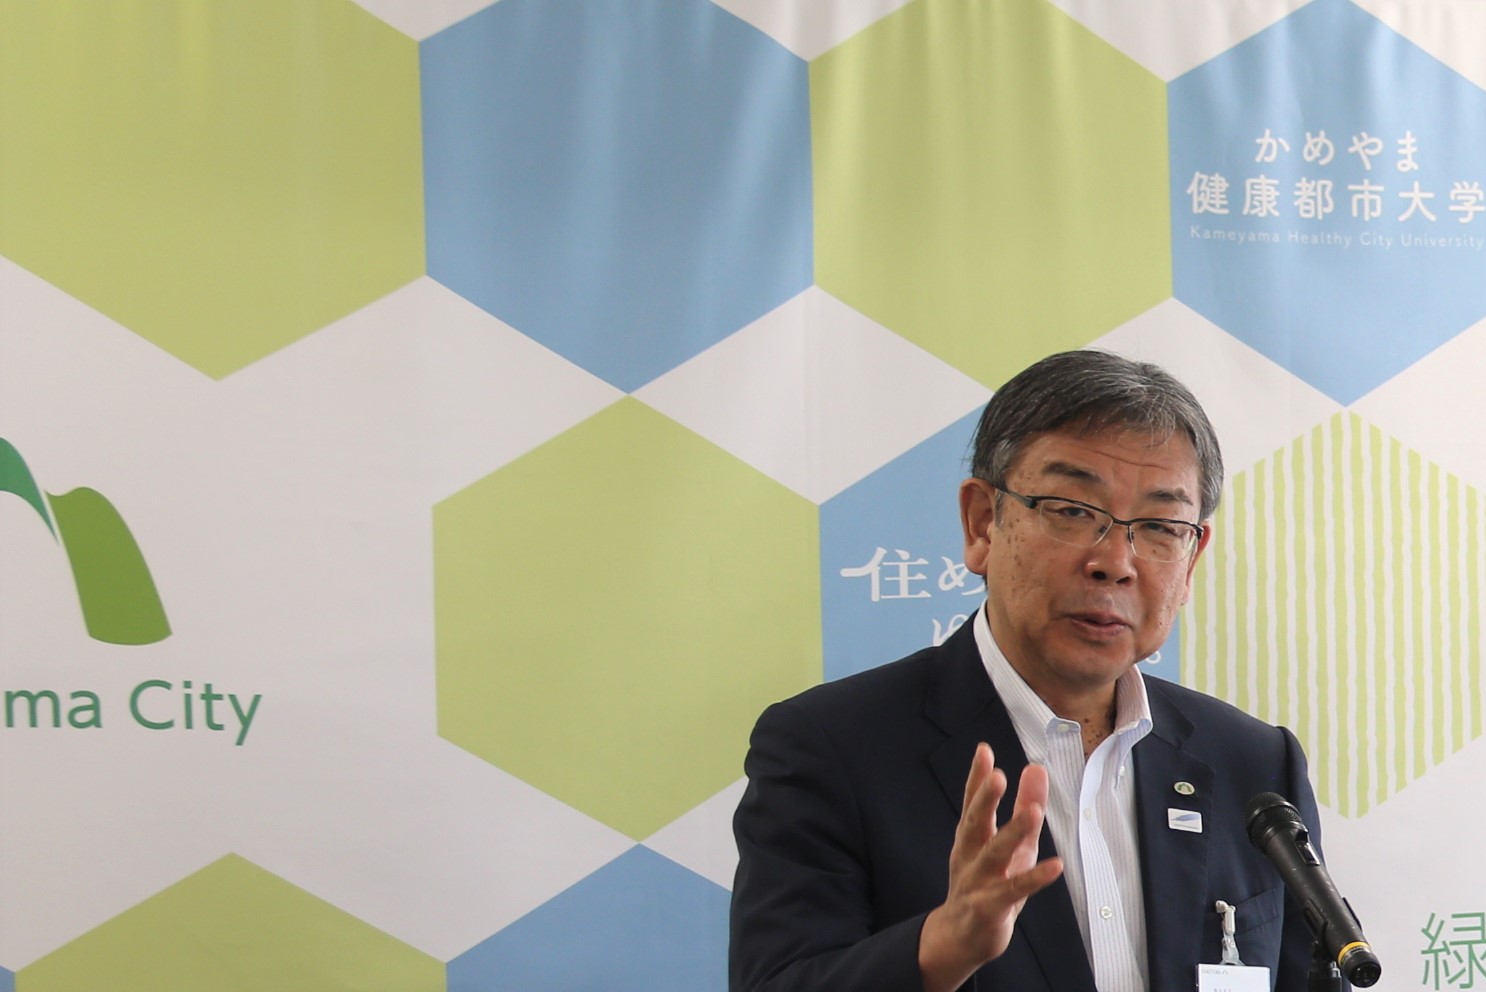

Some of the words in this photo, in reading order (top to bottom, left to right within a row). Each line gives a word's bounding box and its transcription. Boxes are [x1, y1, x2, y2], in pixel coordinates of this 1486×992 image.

[1254, 128, 1419, 173] かめやま
[1186, 171, 1486, 224] 健康都市大学
[1190, 224, 1281, 246] Kameyama
[1287, 230, 1351, 249] Healthy
[1359, 231, 1393, 250] City
[1401, 233, 1485, 250] University
[129, 679, 263, 746] City
